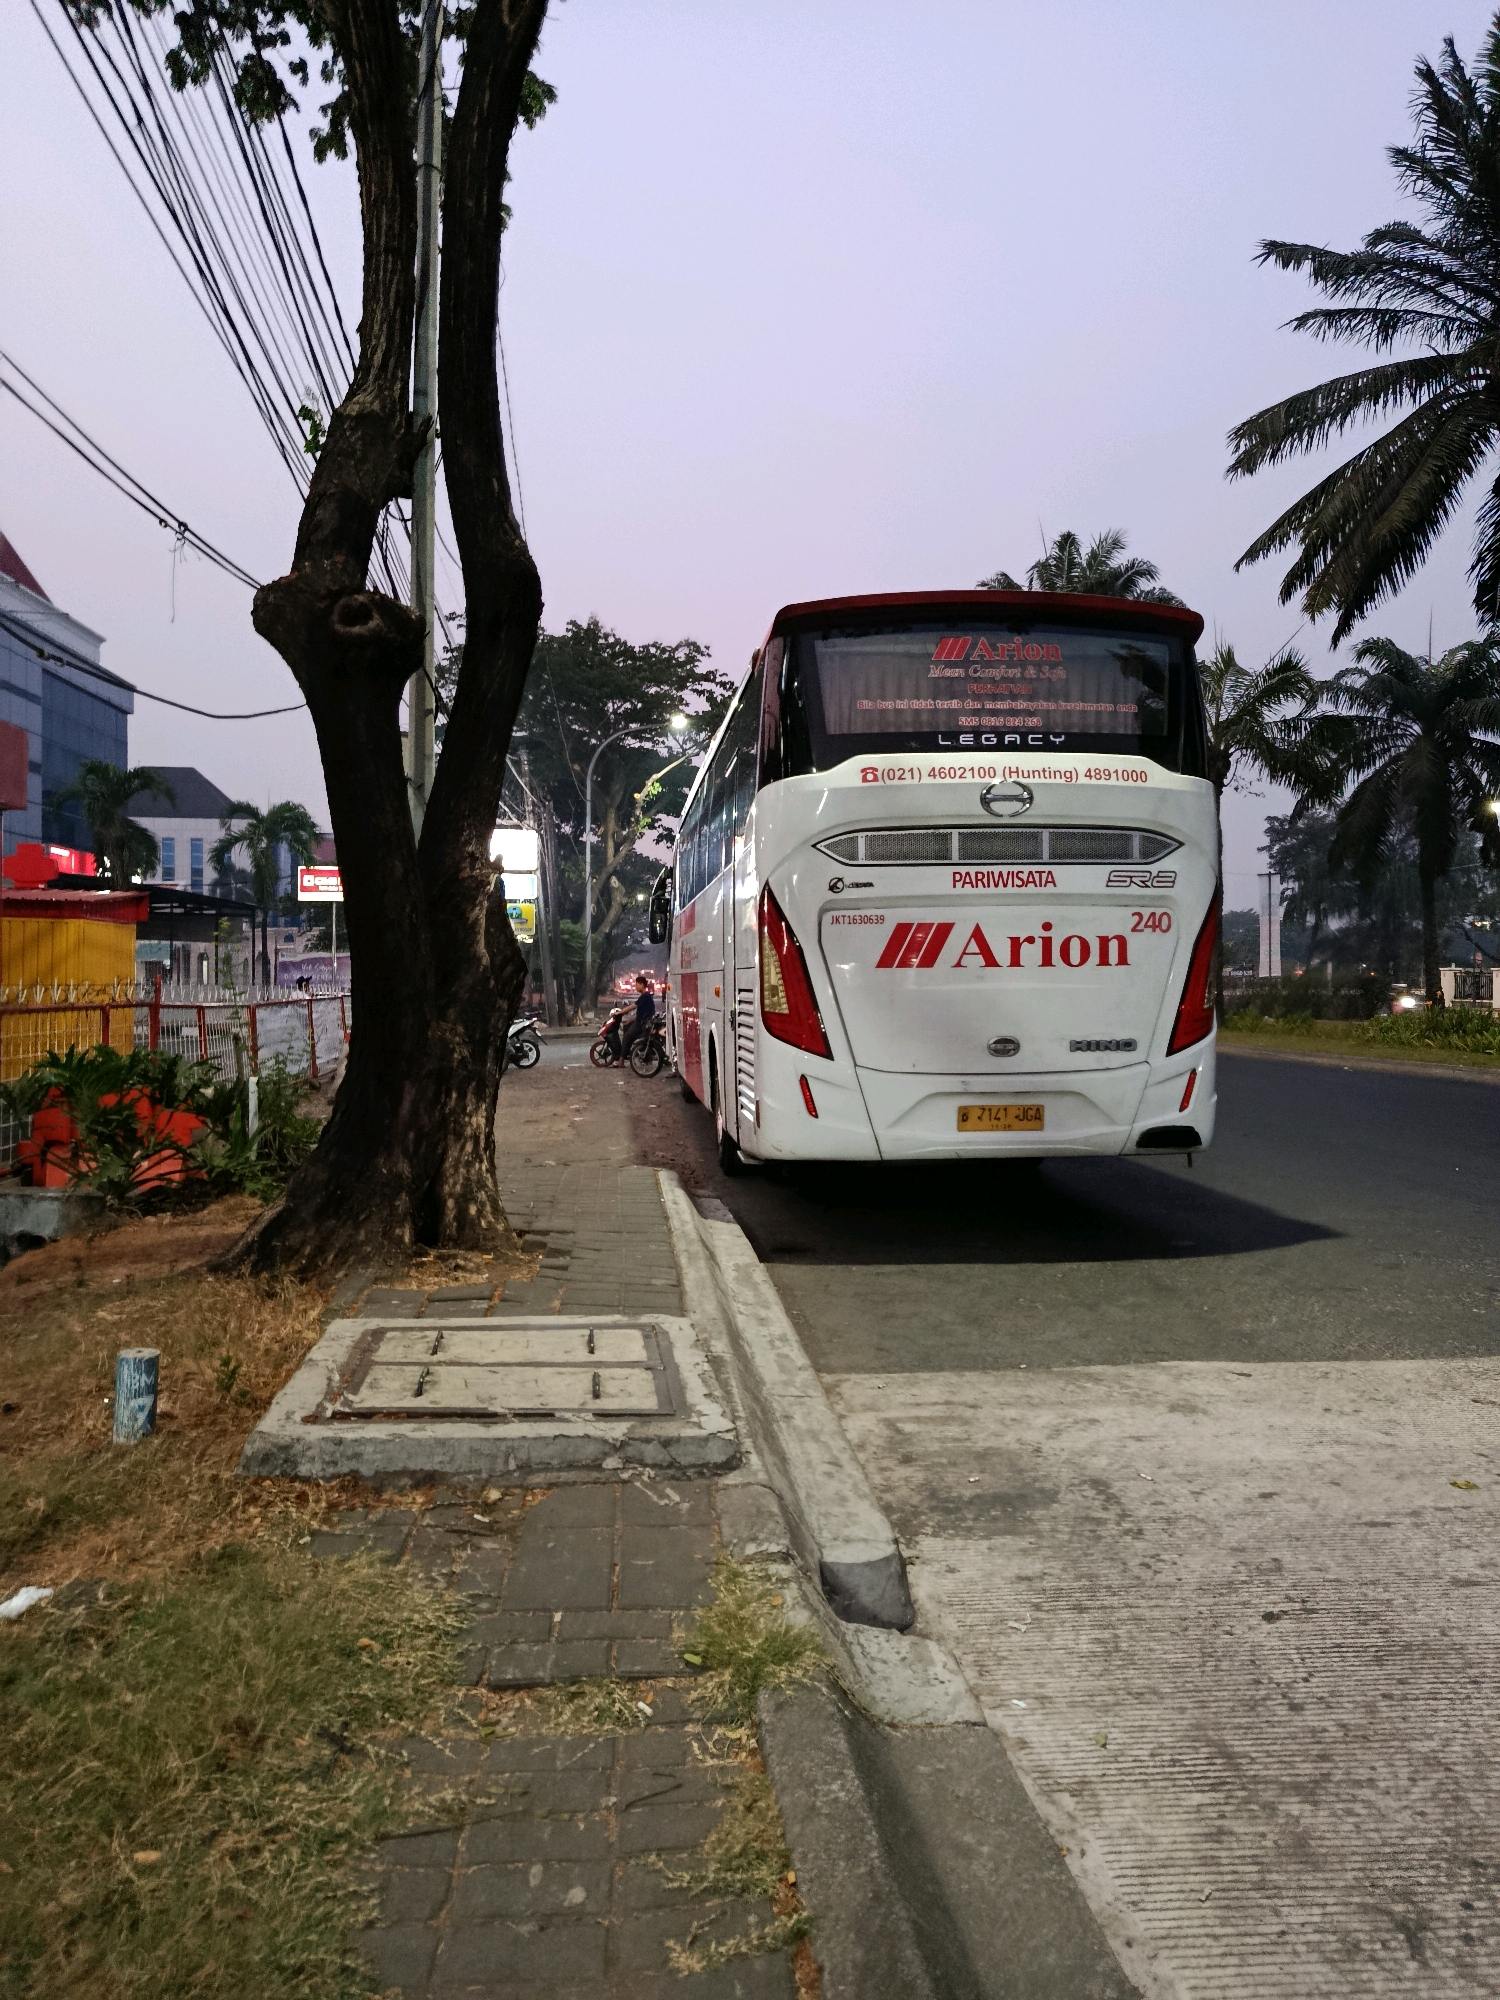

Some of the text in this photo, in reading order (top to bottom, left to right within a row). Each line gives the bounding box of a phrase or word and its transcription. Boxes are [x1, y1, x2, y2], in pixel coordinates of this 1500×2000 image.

[970, 637, 1062, 661] Arion
[969, 665, 1021, 680] Comfort
[1024, 666, 1036, 678] &
[1040, 666, 1066, 680] Safe
[968, 683, 1032, 694] PERHATIAN
[858, 699, 1138, 712] Bila bus ini tidak tertib dan membahayakan keselamatan anda
[958, 717, 979, 726] SMS
[938, 734, 1066, 746] LEGACY
[881, 766, 1148, 783] (021) 4602100 (Hunting) 4891000
[952, 871, 1057, 889] PARIWISATA
[830, 914, 885, 925] JKT1630639
[1130, 911, 1172, 934] 240
[951, 921, 1131, 968] Arion
[1070, 1039, 1137, 1053] HINO
[1017, 1107, 1042, 1122] JGA
